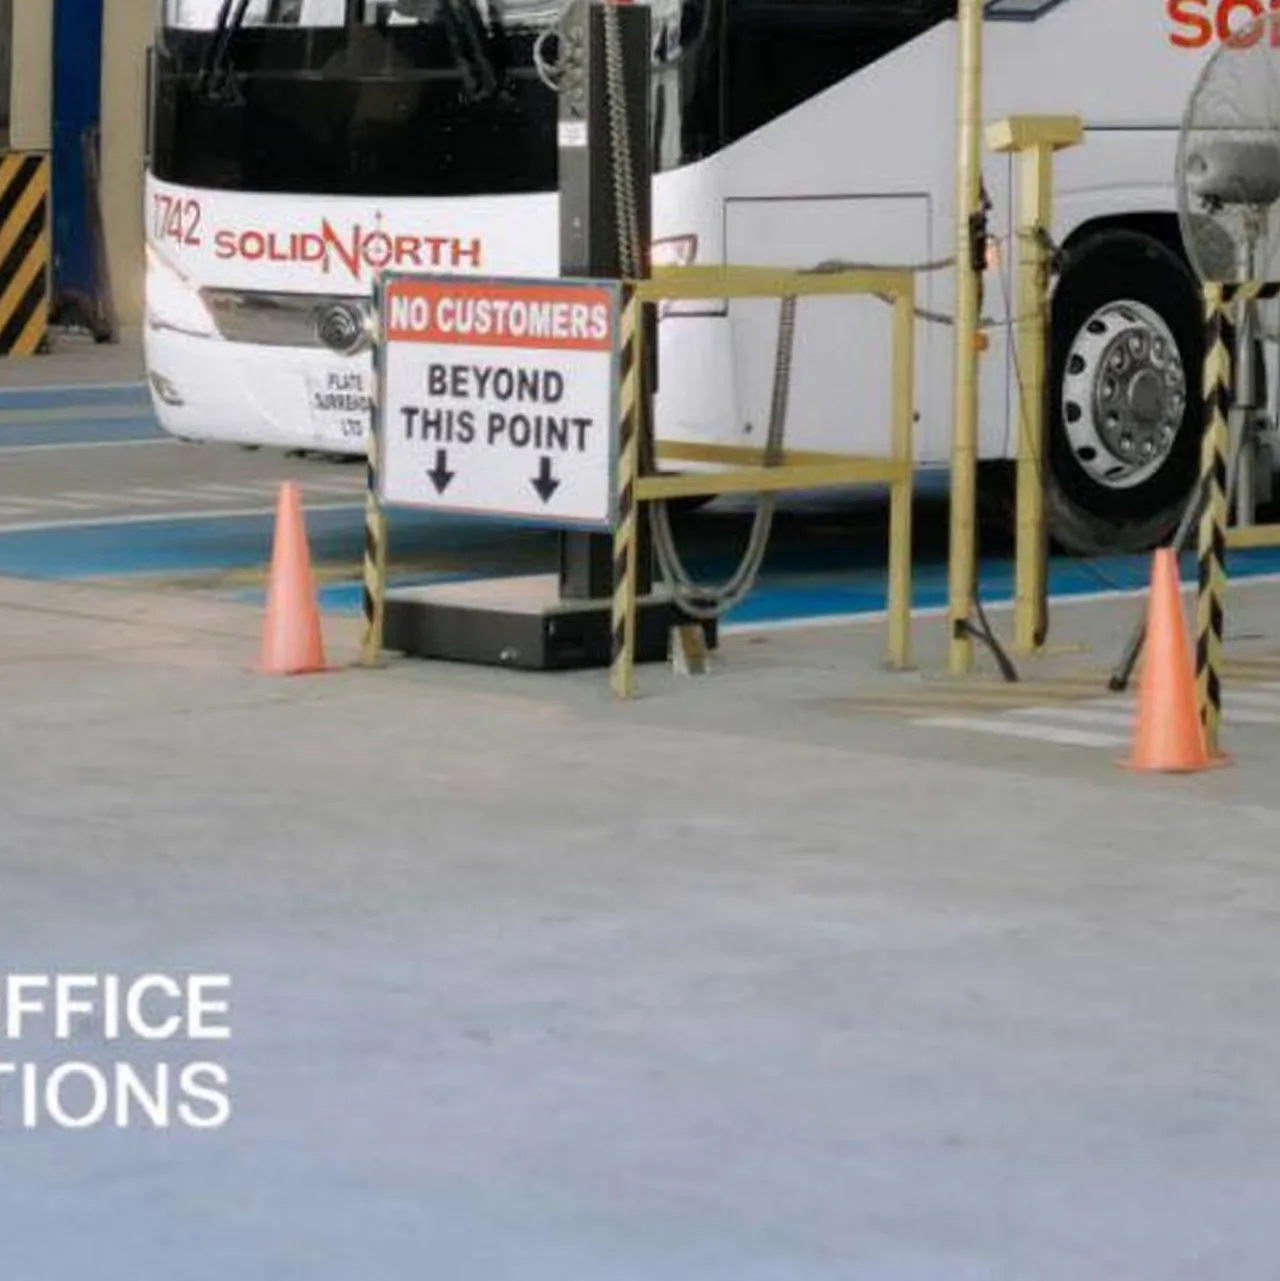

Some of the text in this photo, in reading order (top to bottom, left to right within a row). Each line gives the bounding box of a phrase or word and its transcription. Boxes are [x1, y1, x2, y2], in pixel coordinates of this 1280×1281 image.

[153, 193, 201, 246] 1742
[390, 295, 609, 341] NO CUSTOMERS
[428, 363, 564, 404] BEYOND
[400, 406, 593, 452] THIS POINT
